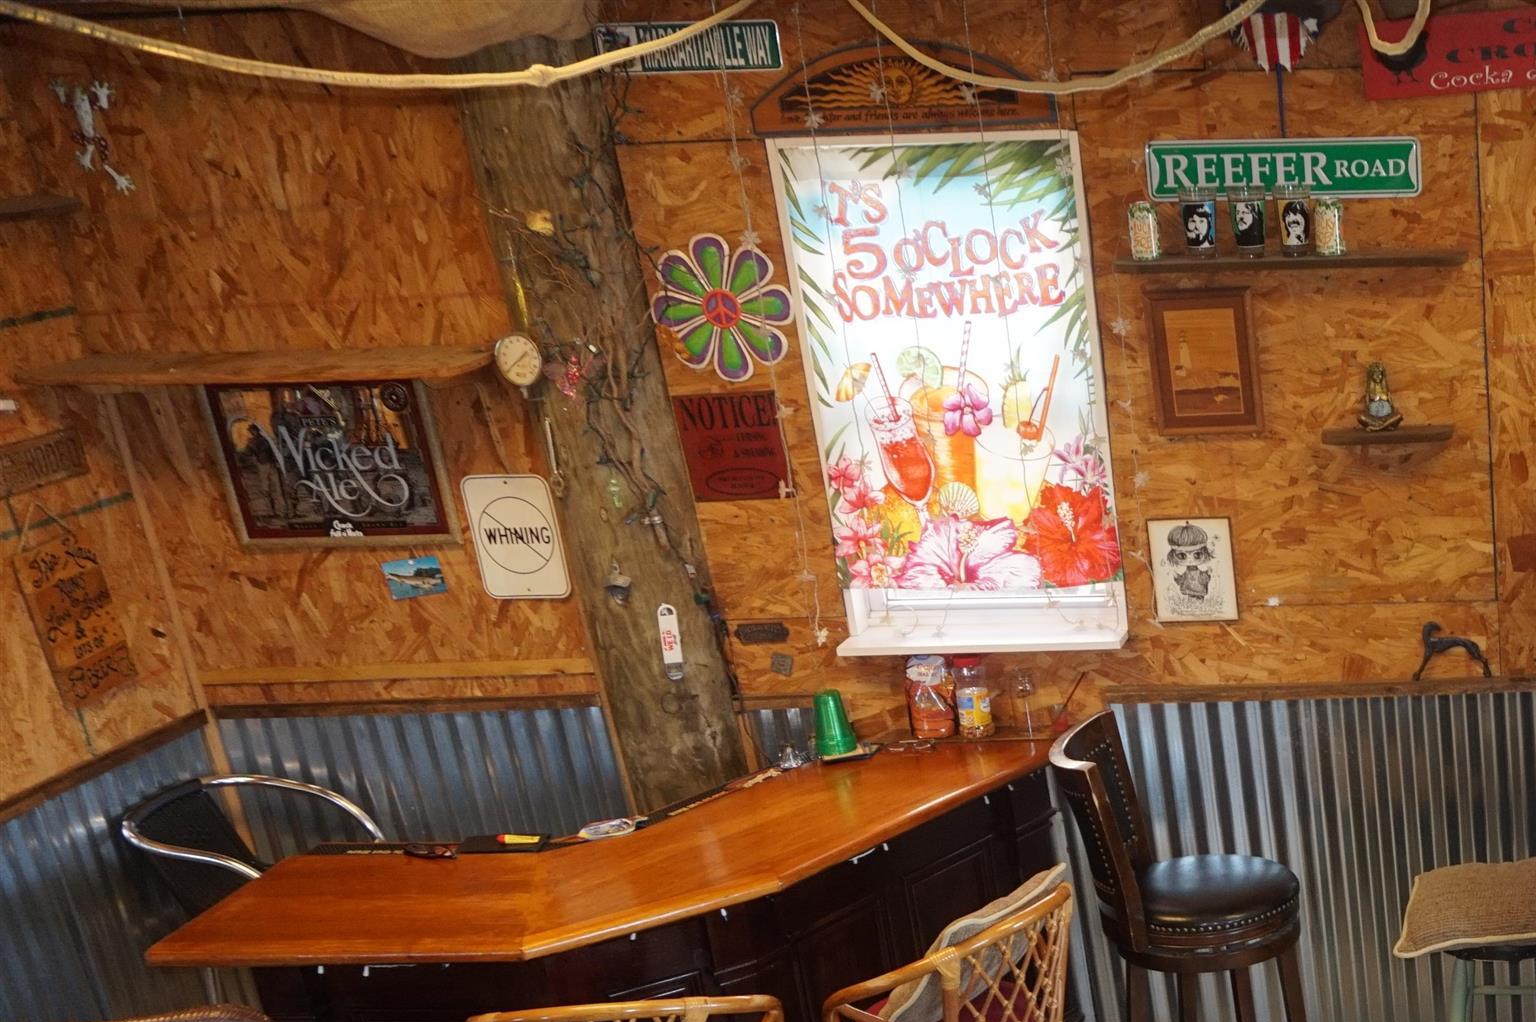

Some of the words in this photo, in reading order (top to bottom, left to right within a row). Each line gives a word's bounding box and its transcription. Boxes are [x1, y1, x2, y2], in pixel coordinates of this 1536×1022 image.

[742, 26, 772, 66] WAY
[1430, 65, 1513, 90] Cocka
[1161, 151, 1333, 188] REEFER
[1334, 158, 1406, 178] ROAD
[841, 227, 888, 281] 5
[893, 209, 1060, 278] O'CLOCK
[832, 262, 1066, 323] SOMEWHERE
[295, 471, 372, 517] Ale
[483, 526, 552, 545] WHINING
